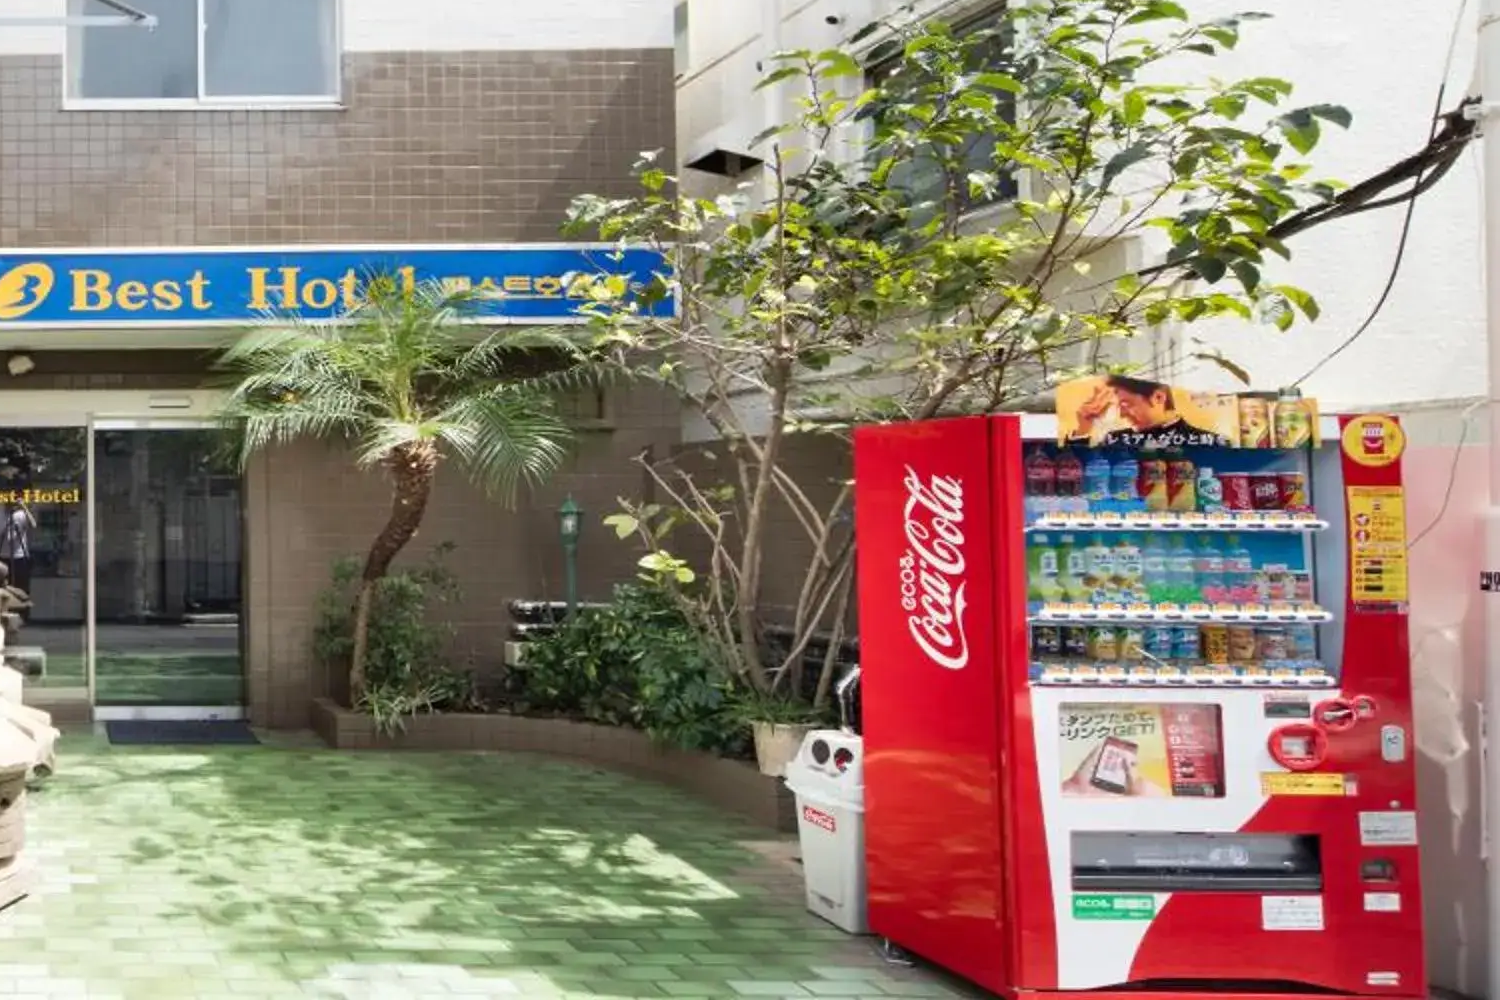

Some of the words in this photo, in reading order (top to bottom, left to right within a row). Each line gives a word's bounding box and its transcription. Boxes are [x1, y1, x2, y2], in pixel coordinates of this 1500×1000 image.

[68, 269, 213, 311] Best
[246, 265, 418, 310] Hotl
[441, 274, 598, 300] 베스트호
[22, 488, 80, 503] Hotel
